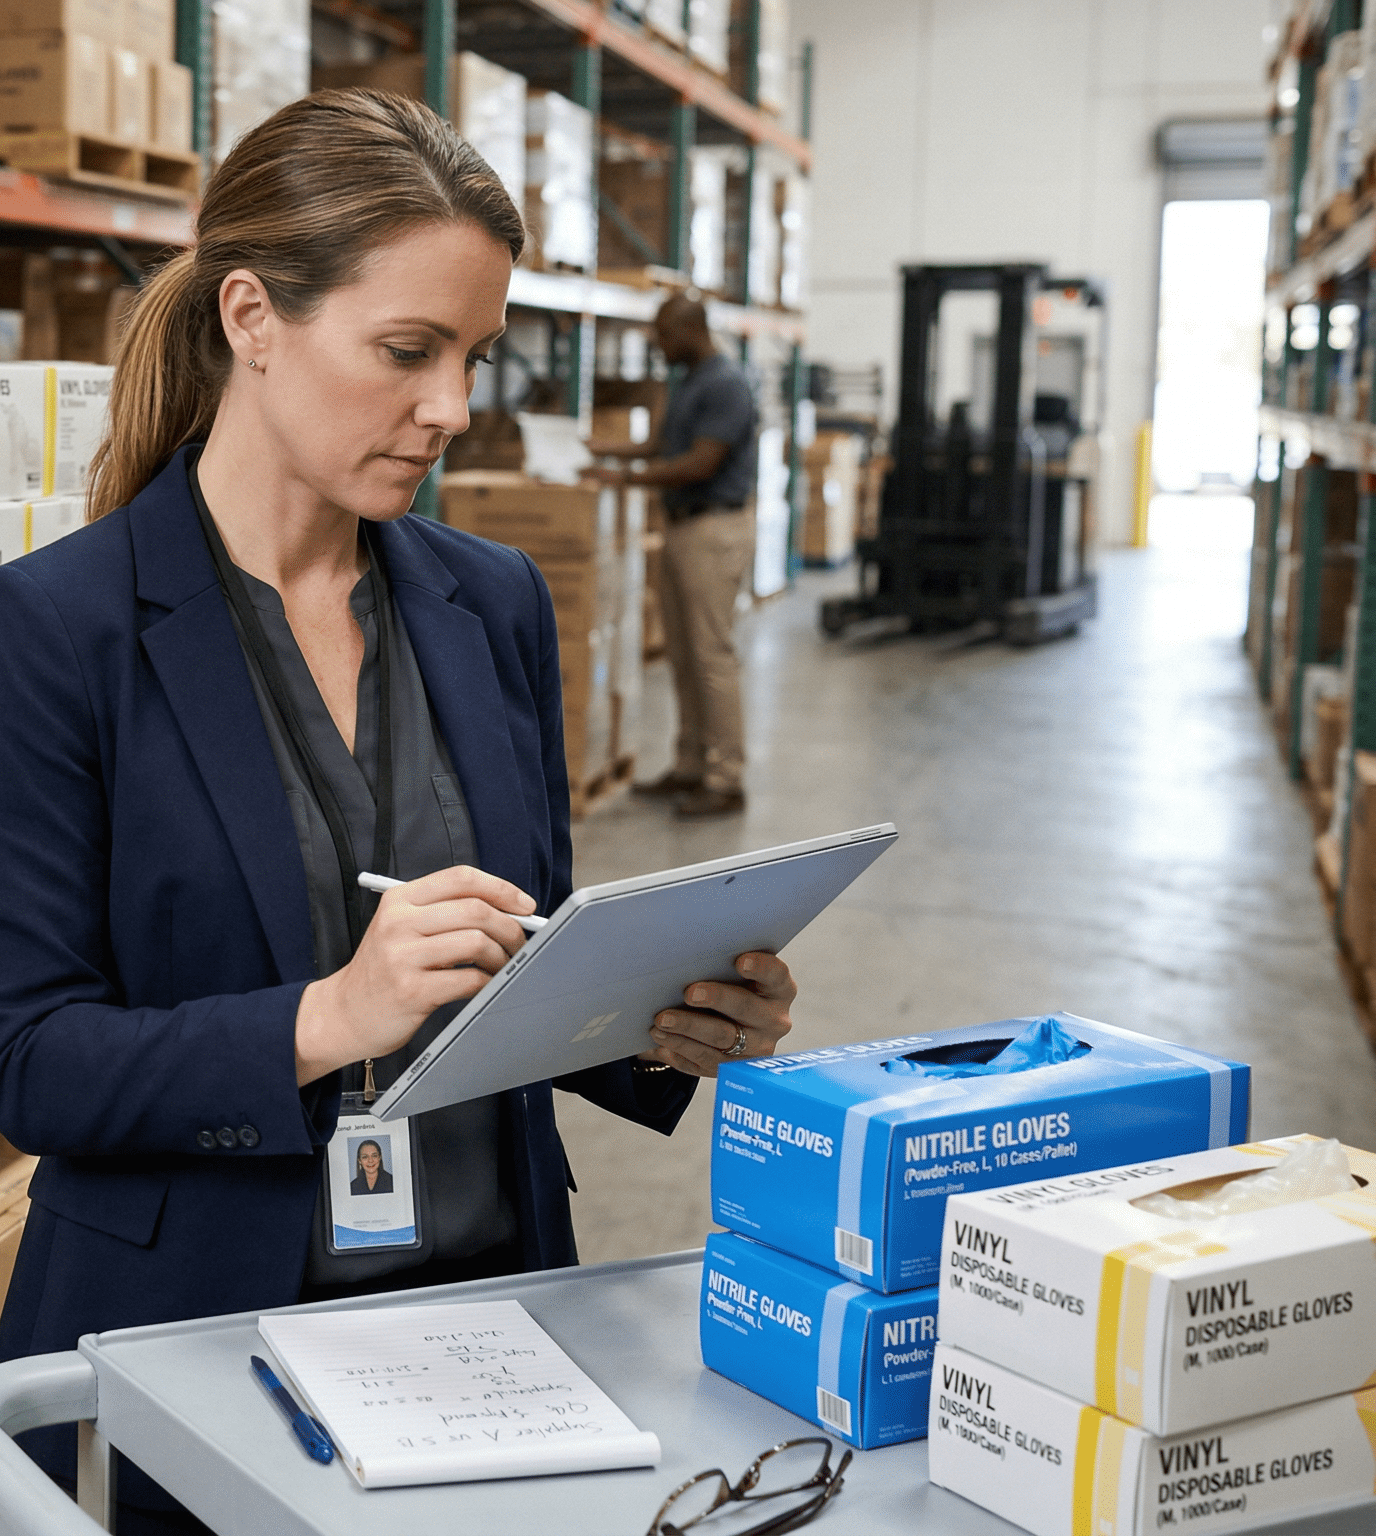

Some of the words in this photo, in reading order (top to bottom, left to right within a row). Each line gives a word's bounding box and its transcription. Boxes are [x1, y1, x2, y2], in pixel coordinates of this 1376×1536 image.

[722, 1101, 775, 1136] NITRILE
[777, 1120, 834, 1158] GLOVES
[905, 1125, 986, 1163] NITRILE
[992, 1112, 1070, 1148] GLOVES
[904, 1160, 979, 1185] (Powder-Free,
[986, 1185, 1077, 1204] VINYL
[1069, 1165, 1175, 1188] GLOVES
[954, 1220, 1013, 1265] VINYL
[709, 1269, 757, 1310] NITRILE
[760, 1295, 812, 1337] GLOVES
[951, 1251, 1029, 1295] DISPOSABLE
[1033, 1282, 1085, 1316] GLOVES
[1186, 1279, 1254, 1318] VINYL
[1186, 1305, 1288, 1348] DISPOSABLE
[1292, 1291, 1353, 1323] GLOVES
[942, 1364, 996, 1411] VINYL
[939, 1395, 1011, 1442] DISPOSABLE
[1014, 1431, 1063, 1467] GLOVES
[1159, 1436, 1229, 1475] VINYL
[1158, 1463, 1265, 1504] DISPOSABLE
[1270, 1449, 1334, 1481] GLOVES
